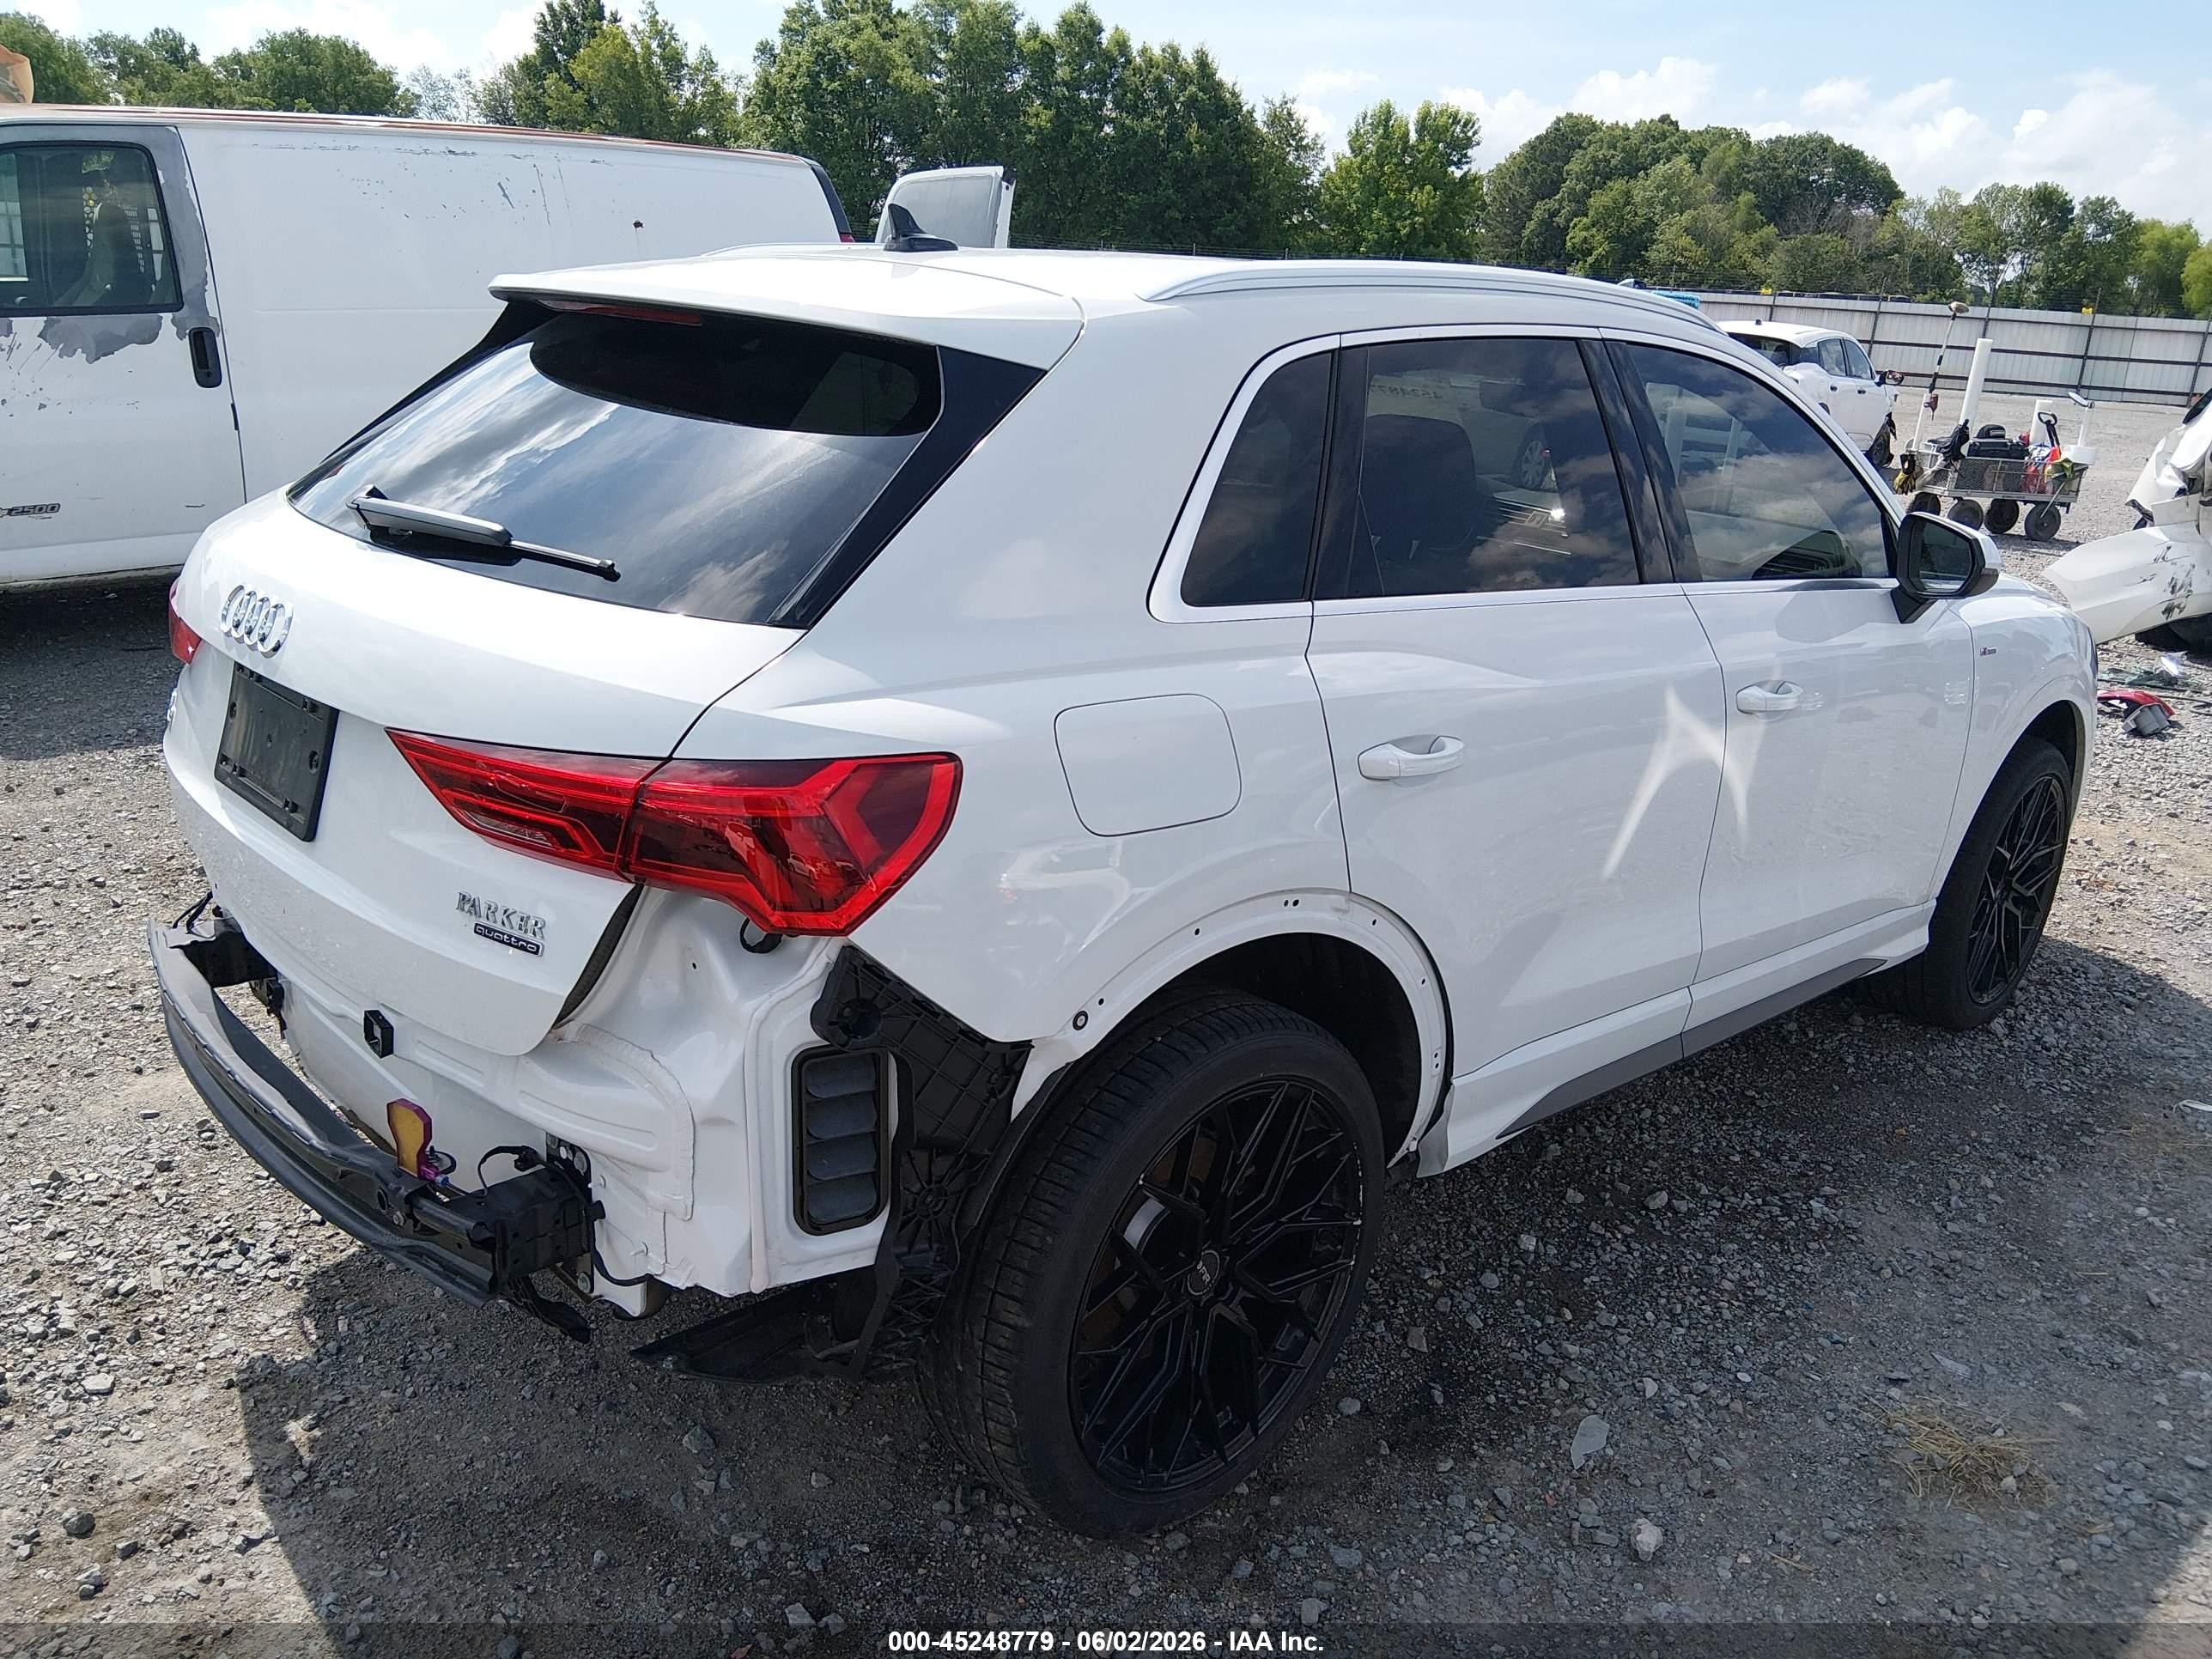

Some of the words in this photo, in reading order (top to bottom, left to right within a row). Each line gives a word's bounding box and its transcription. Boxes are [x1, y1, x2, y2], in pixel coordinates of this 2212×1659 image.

[9, 502, 61, 516] 2500
[455, 891, 546, 941] PARKER
[475, 925, 538, 952] quattro
